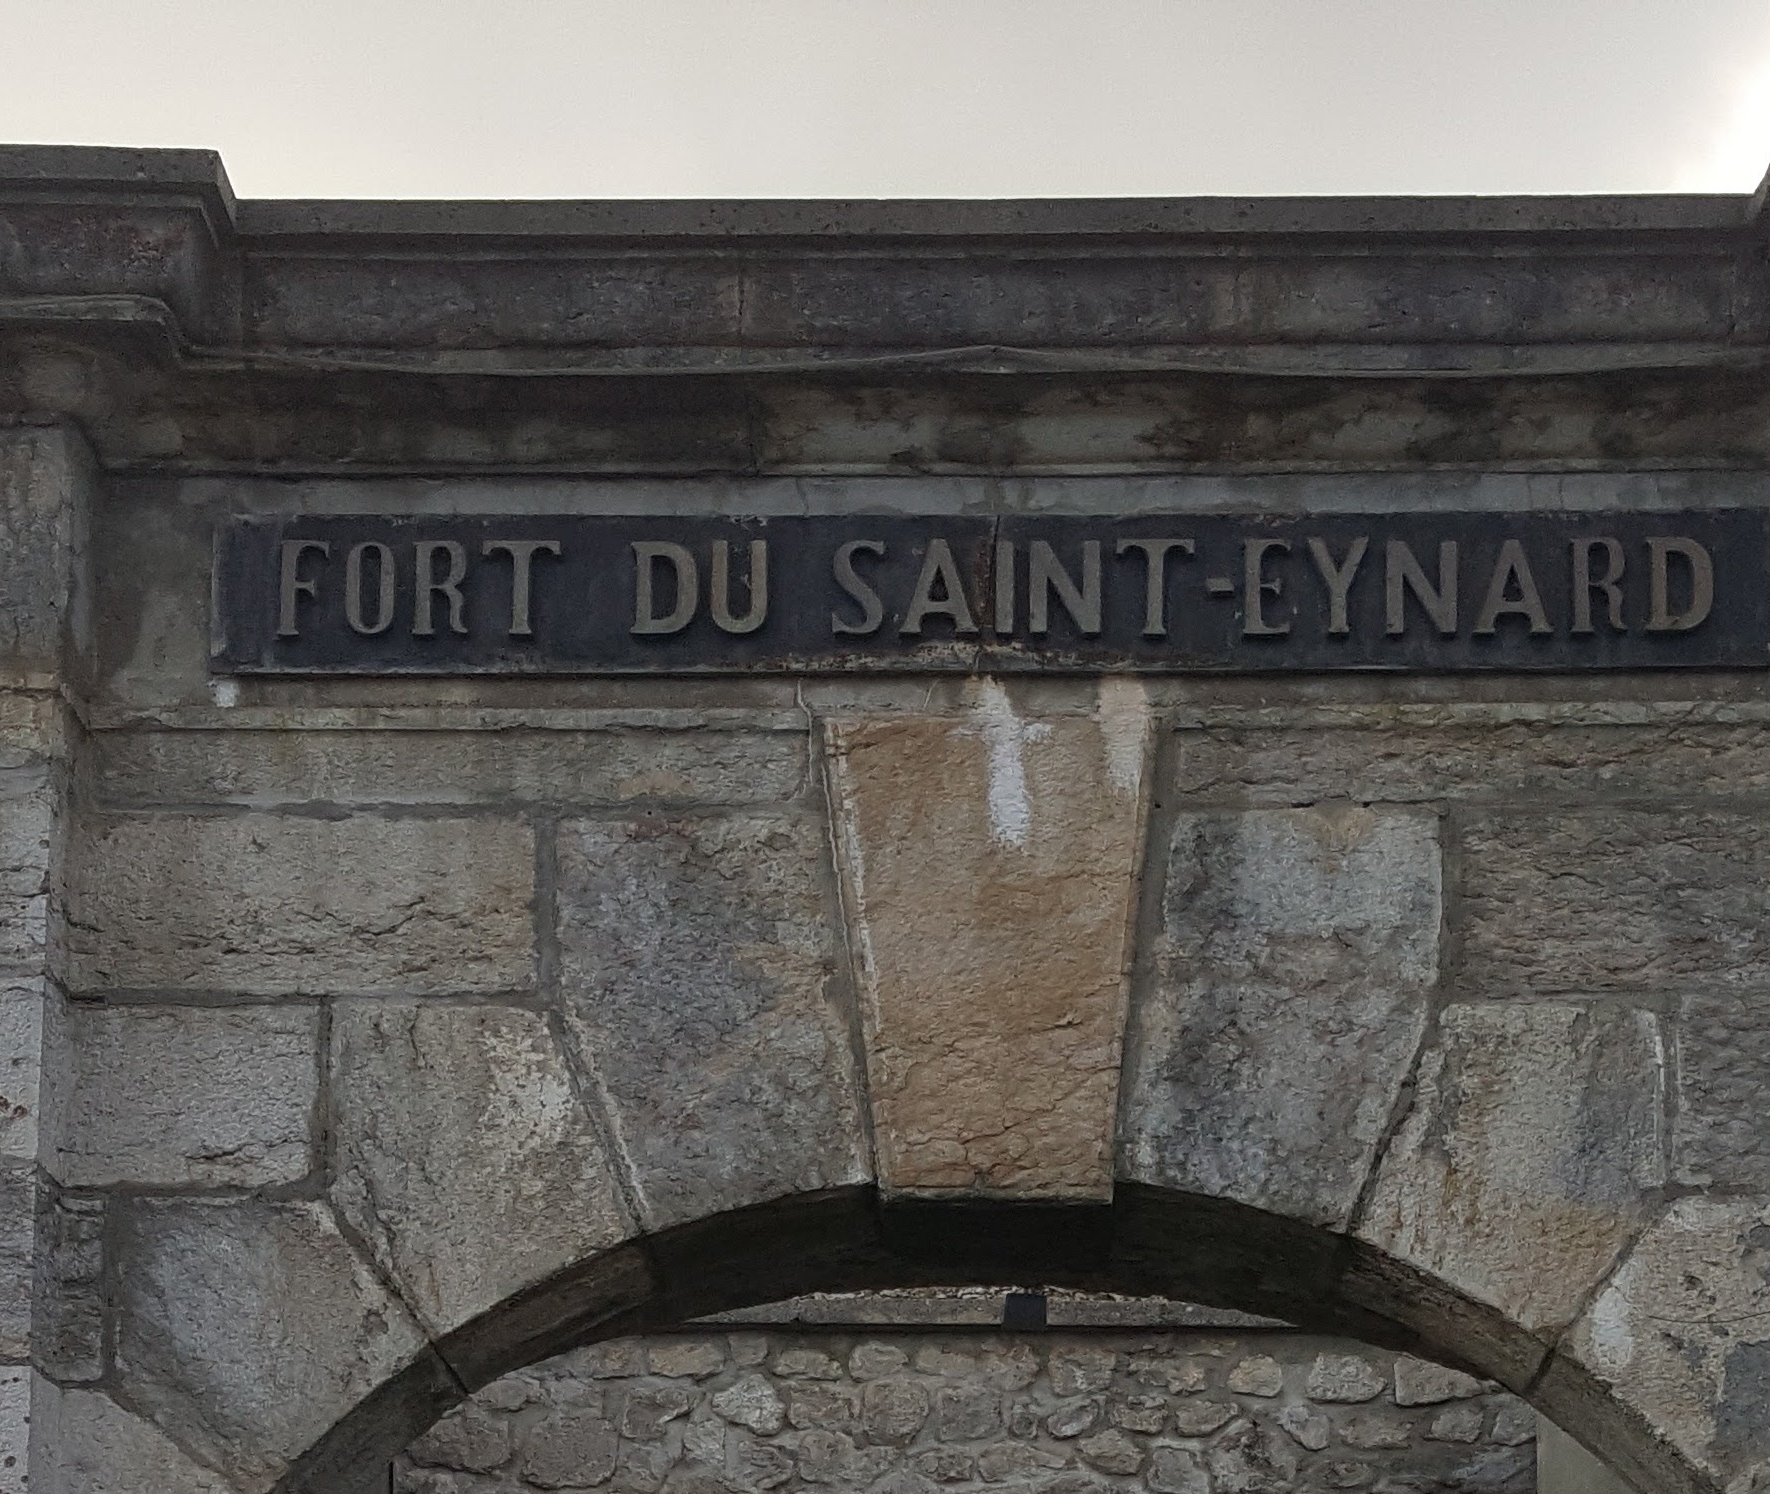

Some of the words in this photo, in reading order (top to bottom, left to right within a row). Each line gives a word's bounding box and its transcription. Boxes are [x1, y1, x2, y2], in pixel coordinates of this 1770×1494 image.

[275, 539, 562, 637] FORT
[629, 539, 769, 635] DU
[830, 536, 1716, 636] SAINT-EYNARD
